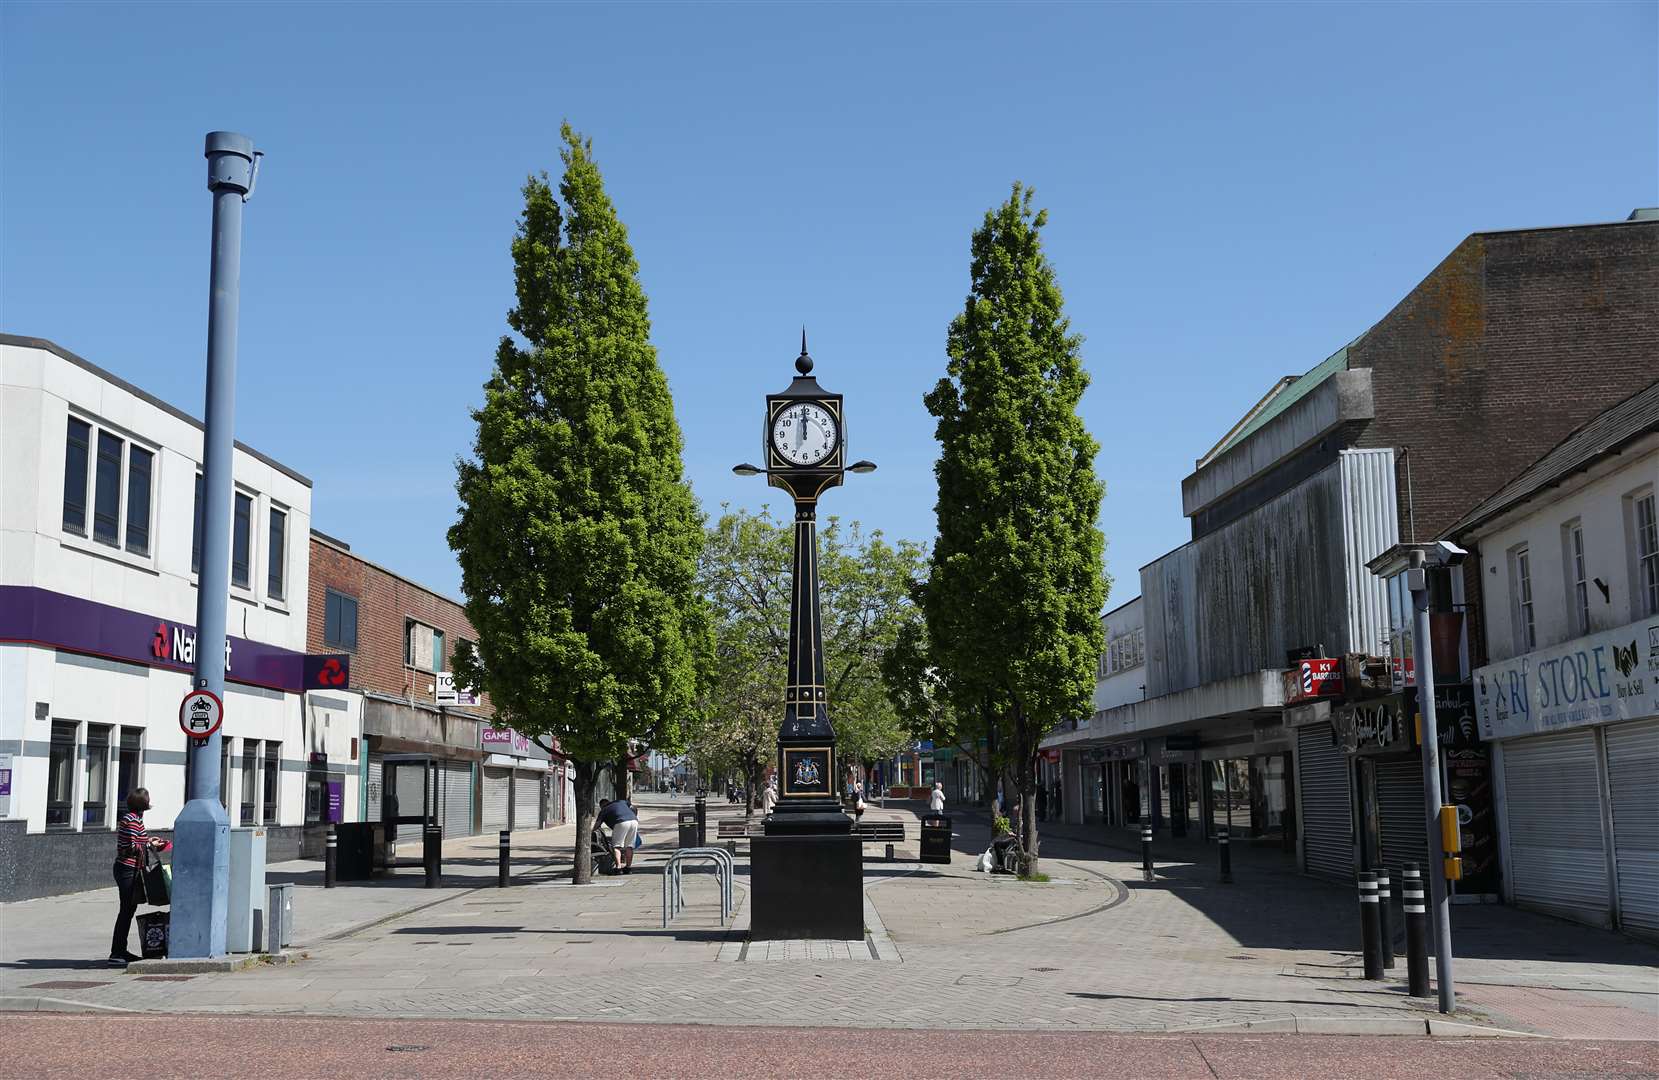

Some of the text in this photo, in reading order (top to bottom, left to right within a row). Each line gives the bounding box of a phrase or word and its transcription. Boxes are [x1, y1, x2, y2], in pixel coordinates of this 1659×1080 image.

[1320, 663, 1331, 671] K1
[438, 676, 453, 686] TO
[1538, 646, 1610, 708] STORE
[484, 732, 510, 741] GAME
[1438, 725, 1455, 744] rill
